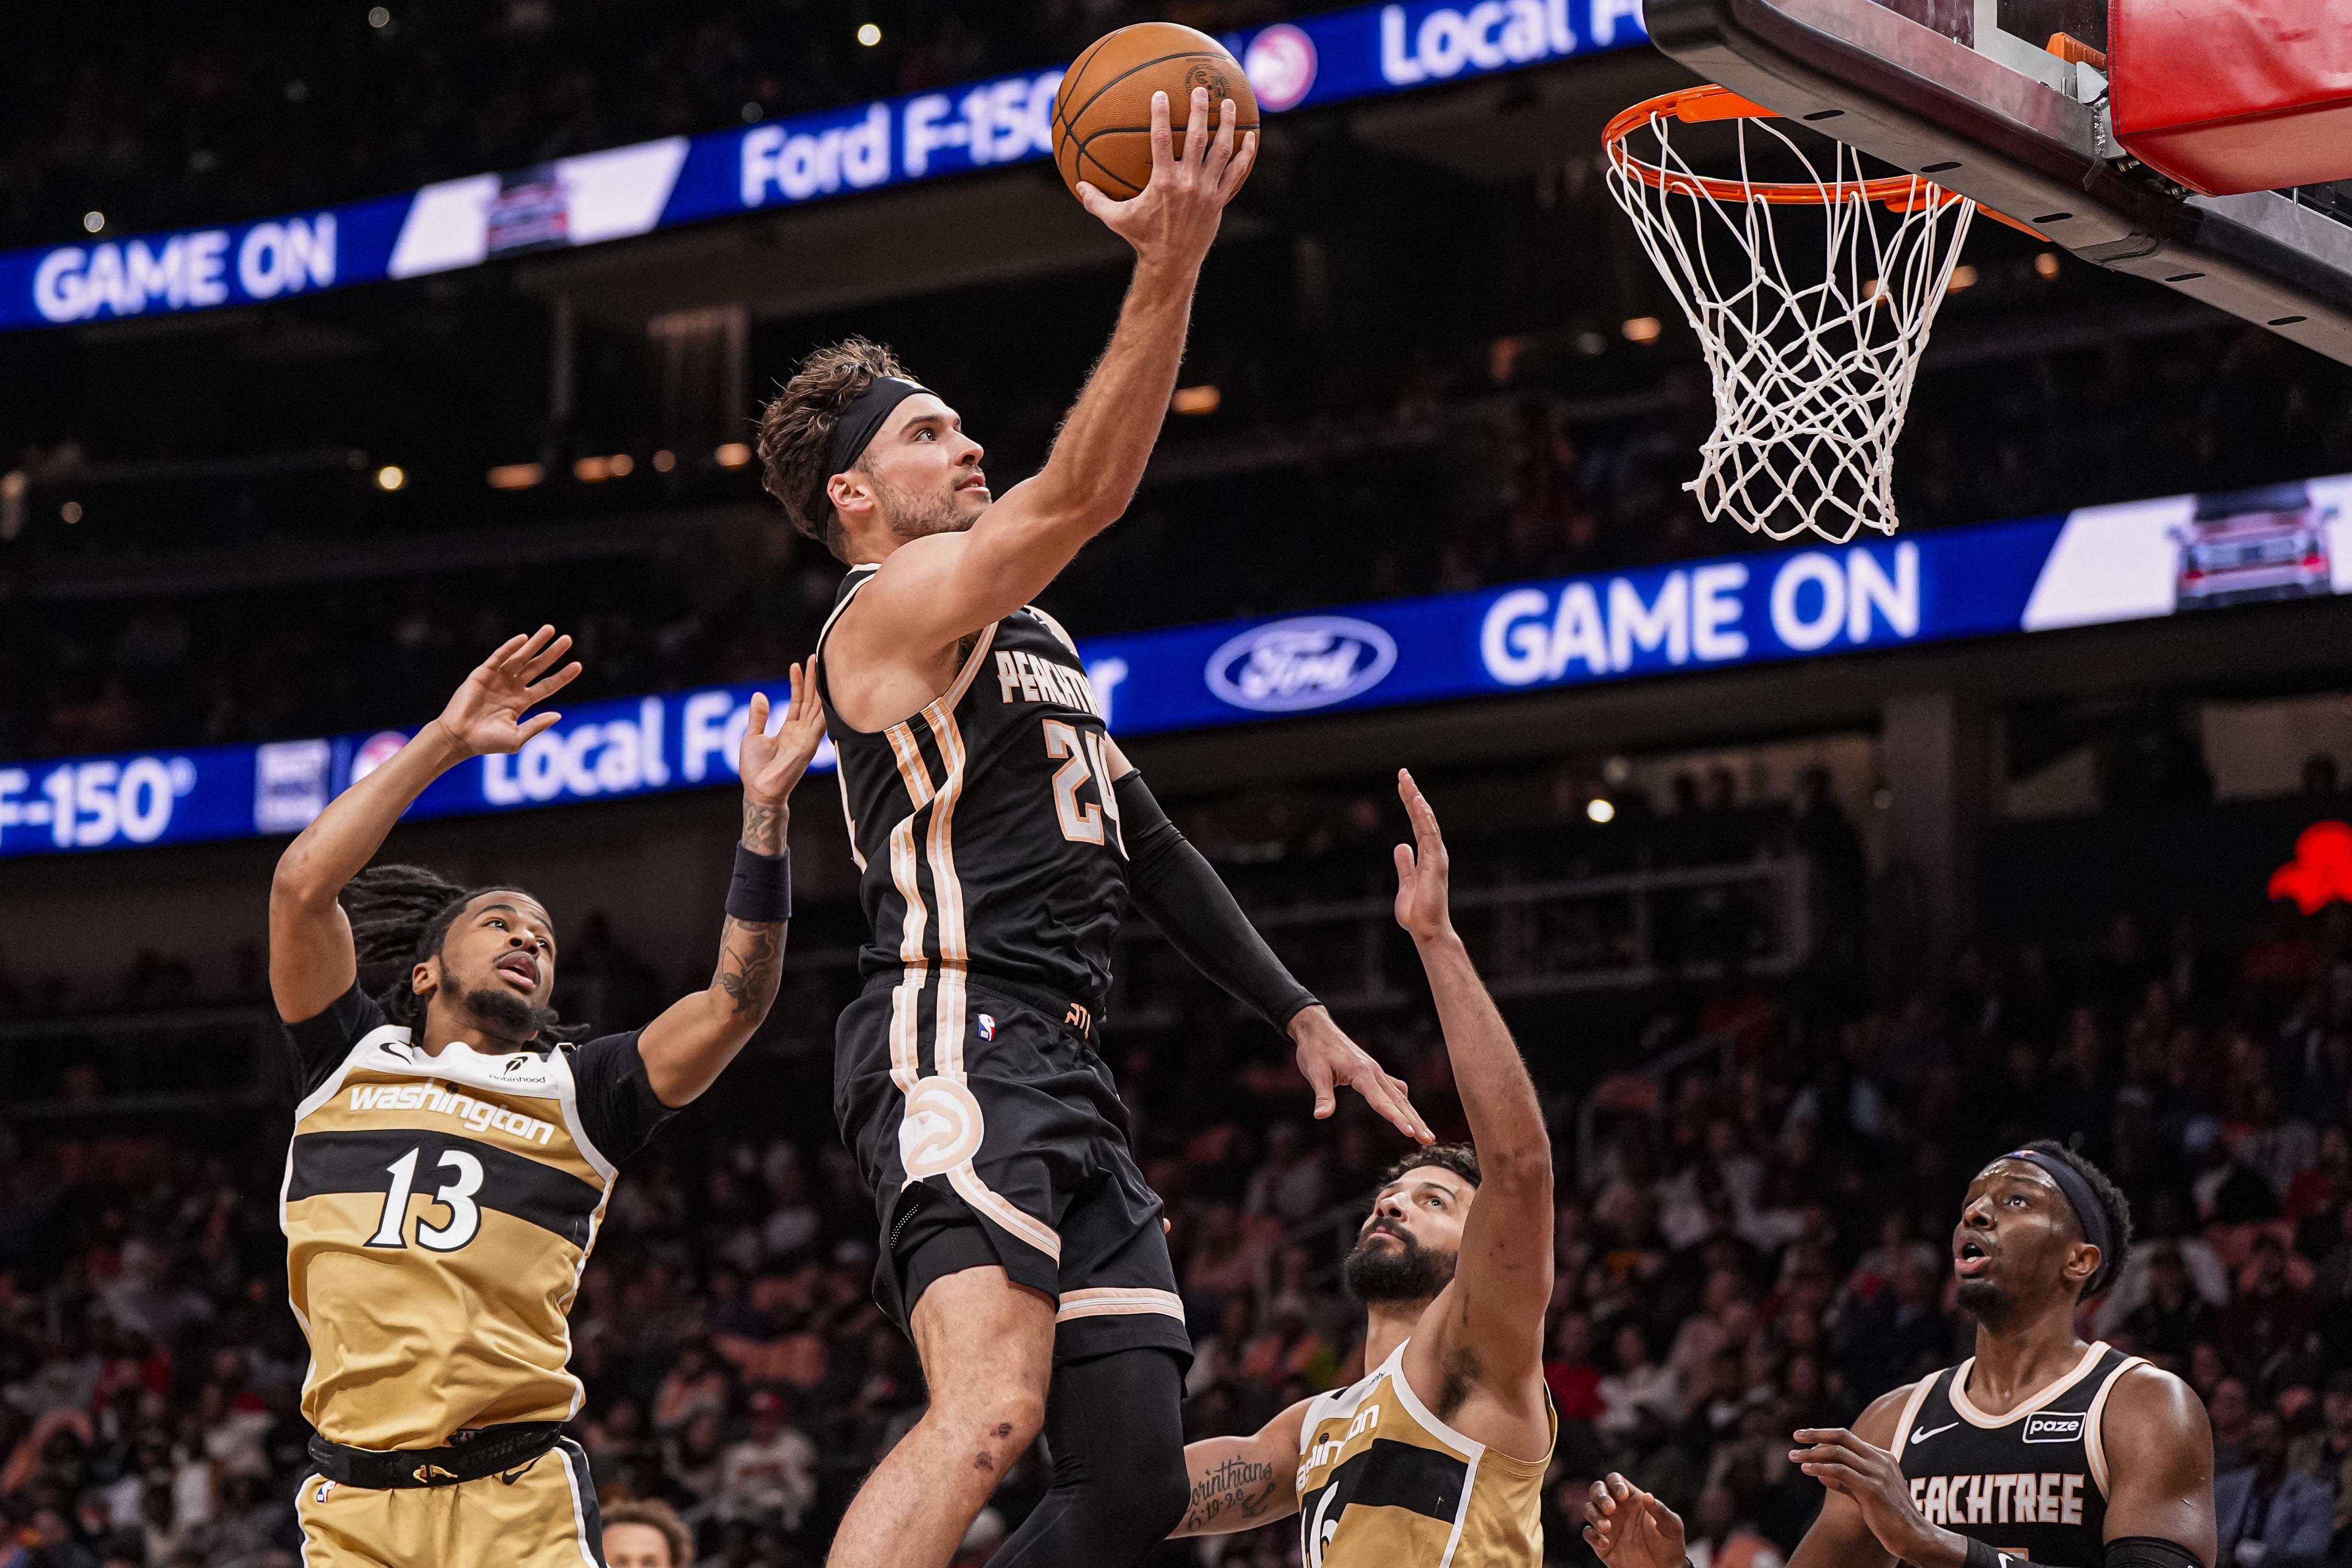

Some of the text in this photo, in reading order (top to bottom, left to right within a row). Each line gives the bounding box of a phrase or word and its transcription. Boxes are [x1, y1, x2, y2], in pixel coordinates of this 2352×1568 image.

[1381, 0, 1577, 85] Local
[740, 101, 891, 207] Ford
[34, 212, 337, 322] GAME ON
[1480, 541, 1919, 686] GAME ON
[482, 696, 669, 805] Local
[349, 1079, 555, 1146] washington
[362, 1146, 484, 1252] 13
[2030, 1420, 2079, 1434] paze
[1191, 1454, 1273, 1506] orinthians
[1909, 1473, 2084, 1525] EACHTREE
